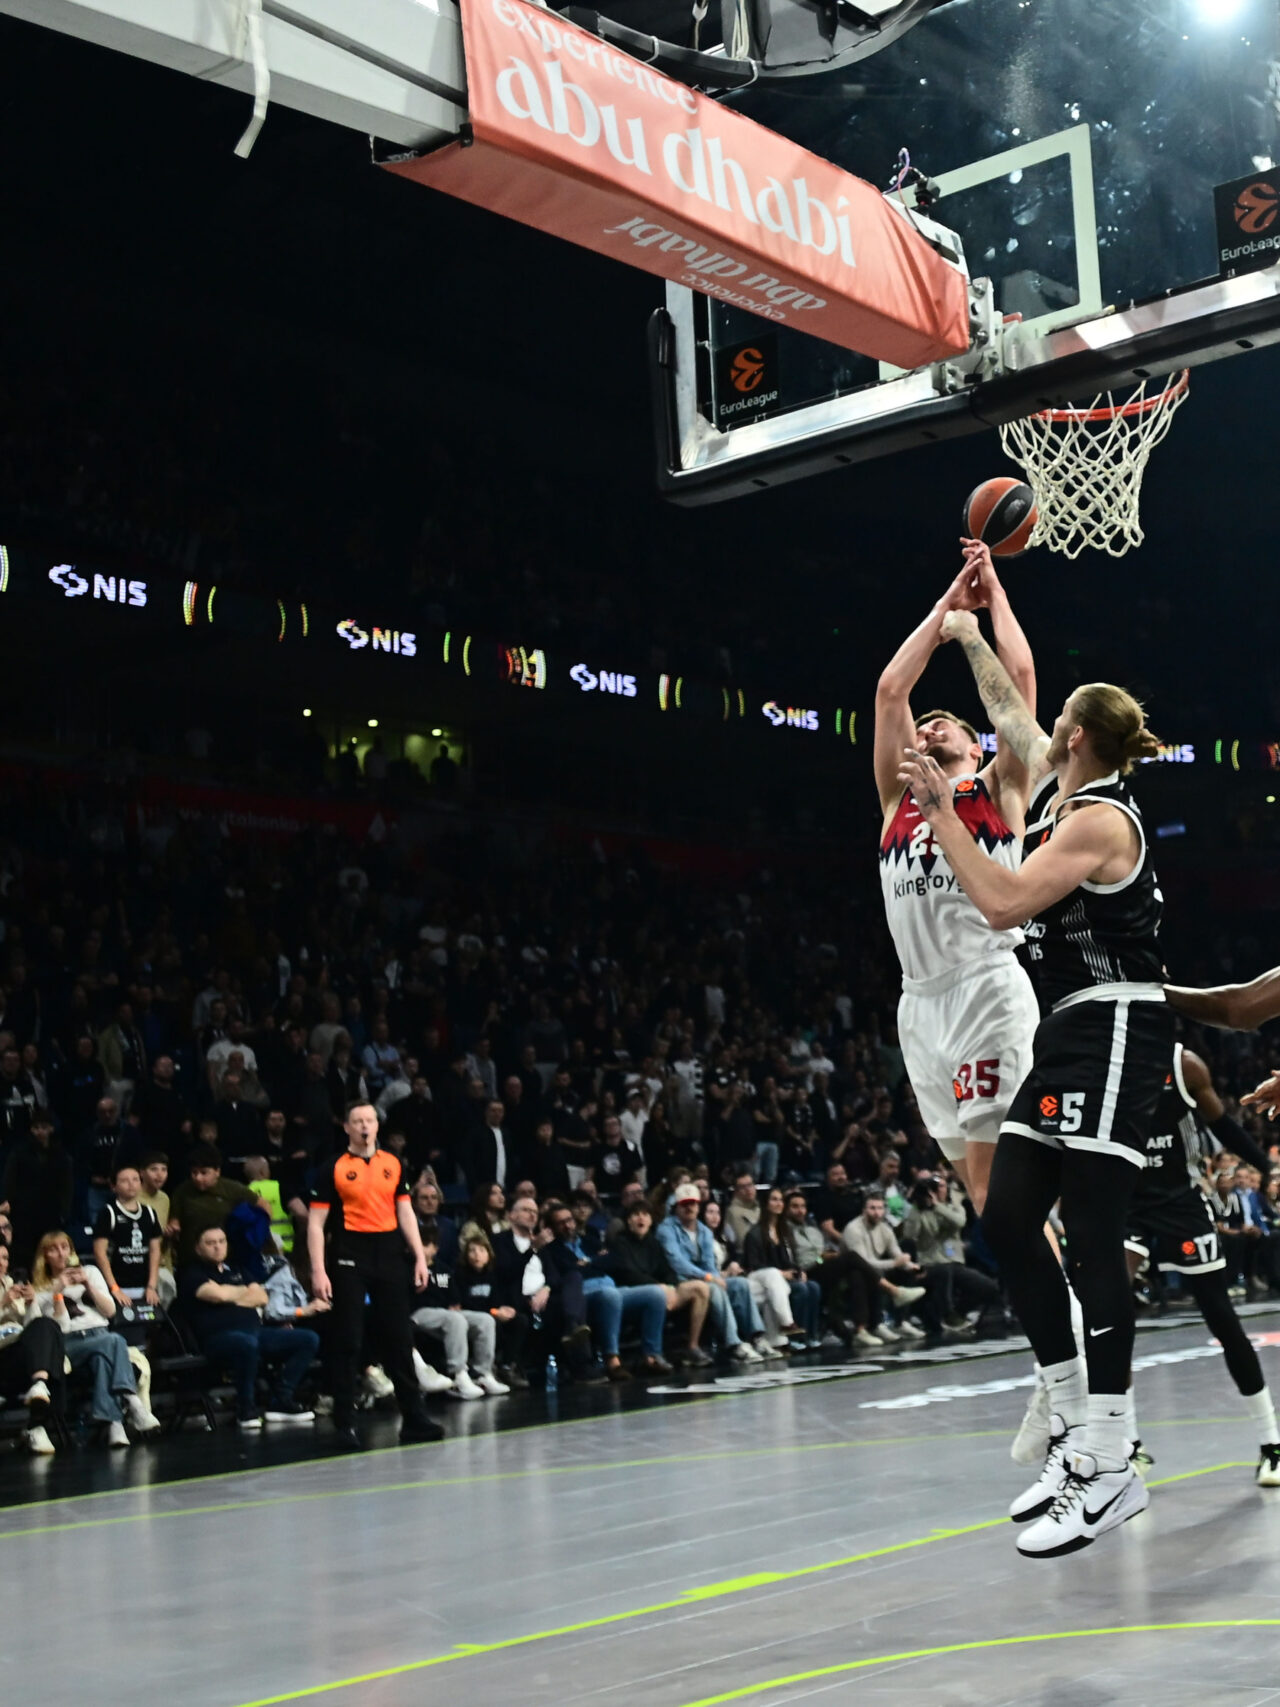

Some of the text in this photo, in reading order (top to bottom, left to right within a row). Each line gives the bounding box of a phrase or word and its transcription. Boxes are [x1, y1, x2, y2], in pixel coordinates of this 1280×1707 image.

[493, 0, 697, 114] experience
[496, 56, 857, 267] abu dhabi
[603, 216, 827, 310] abu dhabi
[720, 390, 778, 415] EuroLeague
[94, 573, 147, 606] NIS
[373, 627, 417, 657] NIS
[599, 670, 637, 697] NIS
[787, 706, 819, 731] NIS
[1157, 744, 1195, 763] NIS
[894, 873, 966, 899] kingroy
[957, 1058, 1000, 1101] 25
[1059, 1092, 1086, 1132] 5
[1193, 1232, 1218, 1263] 17
